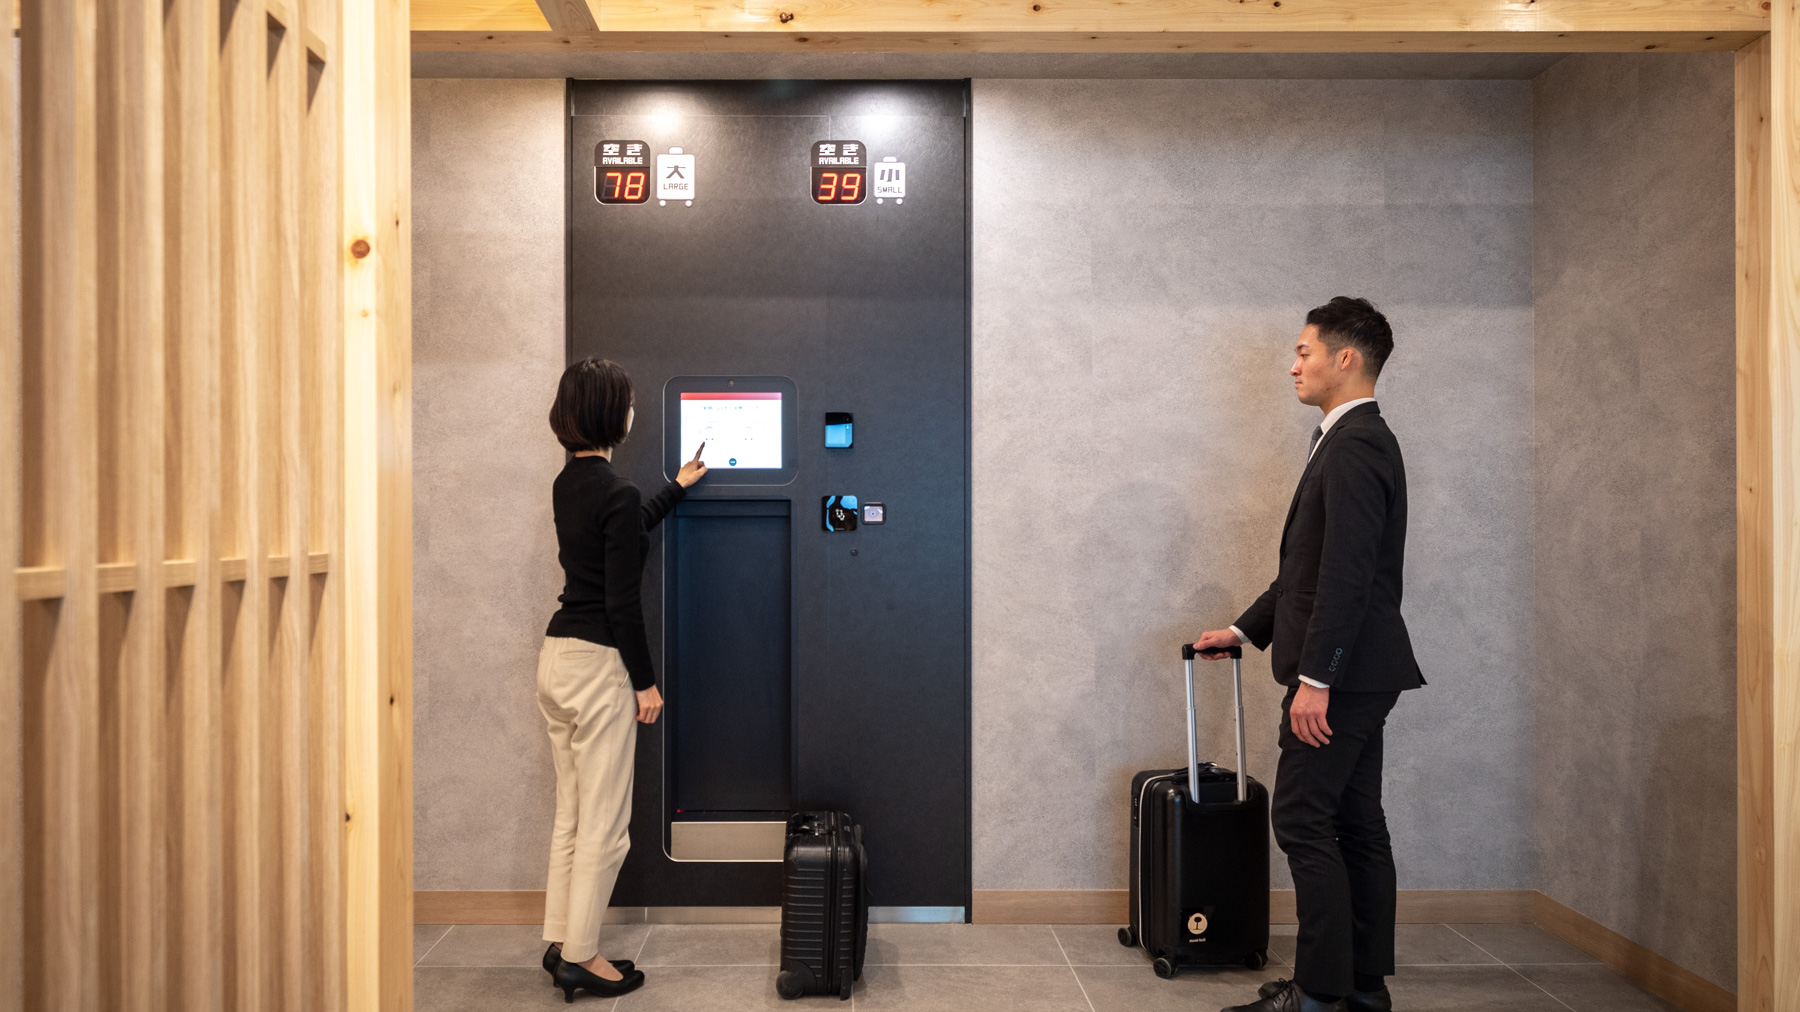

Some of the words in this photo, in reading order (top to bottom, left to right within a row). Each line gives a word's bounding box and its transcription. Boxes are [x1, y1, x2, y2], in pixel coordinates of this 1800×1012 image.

[602, 143, 643, 156] 空き
[818, 143, 859, 156] 空き
[602, 157, 643, 165] AVAILABLE
[818, 157, 859, 165] AVAILABLE
[666, 165, 686, 179] 大
[879, 168, 900, 182] 小
[605, 172, 646, 200] 78
[817, 172, 862, 201] 39
